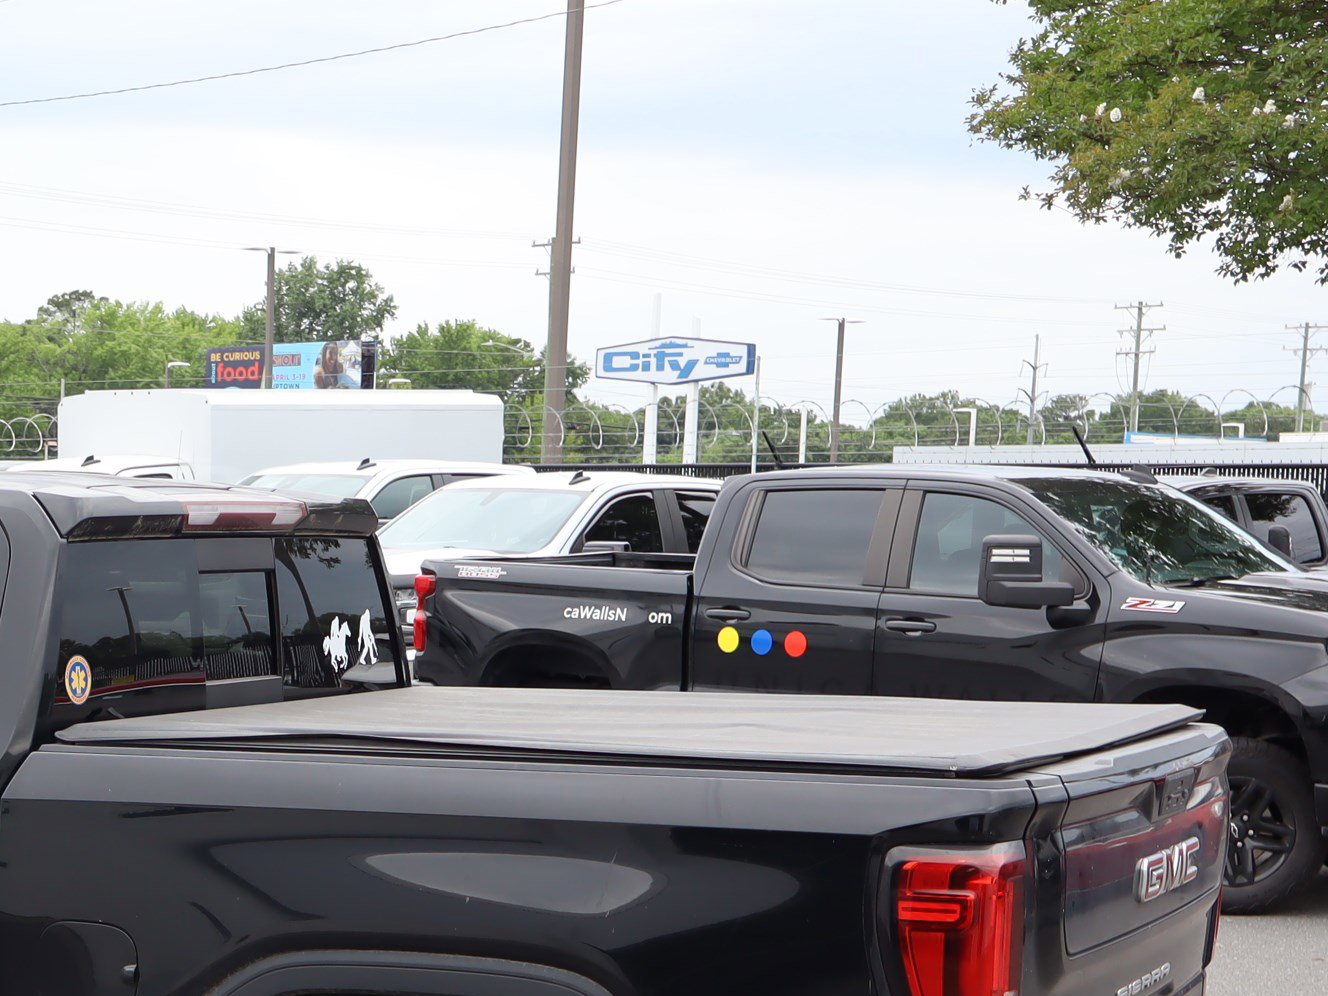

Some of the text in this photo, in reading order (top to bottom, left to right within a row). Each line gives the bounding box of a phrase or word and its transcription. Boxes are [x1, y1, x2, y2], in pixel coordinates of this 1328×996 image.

[210, 351, 260, 362] BE CURIOUS
[603, 351, 699, 379] City
[217, 361, 259, 382] food
[1120, 597, 1186, 614] Z71
[648, 612, 672, 624] om
[1133, 837, 1199, 903] GMC
